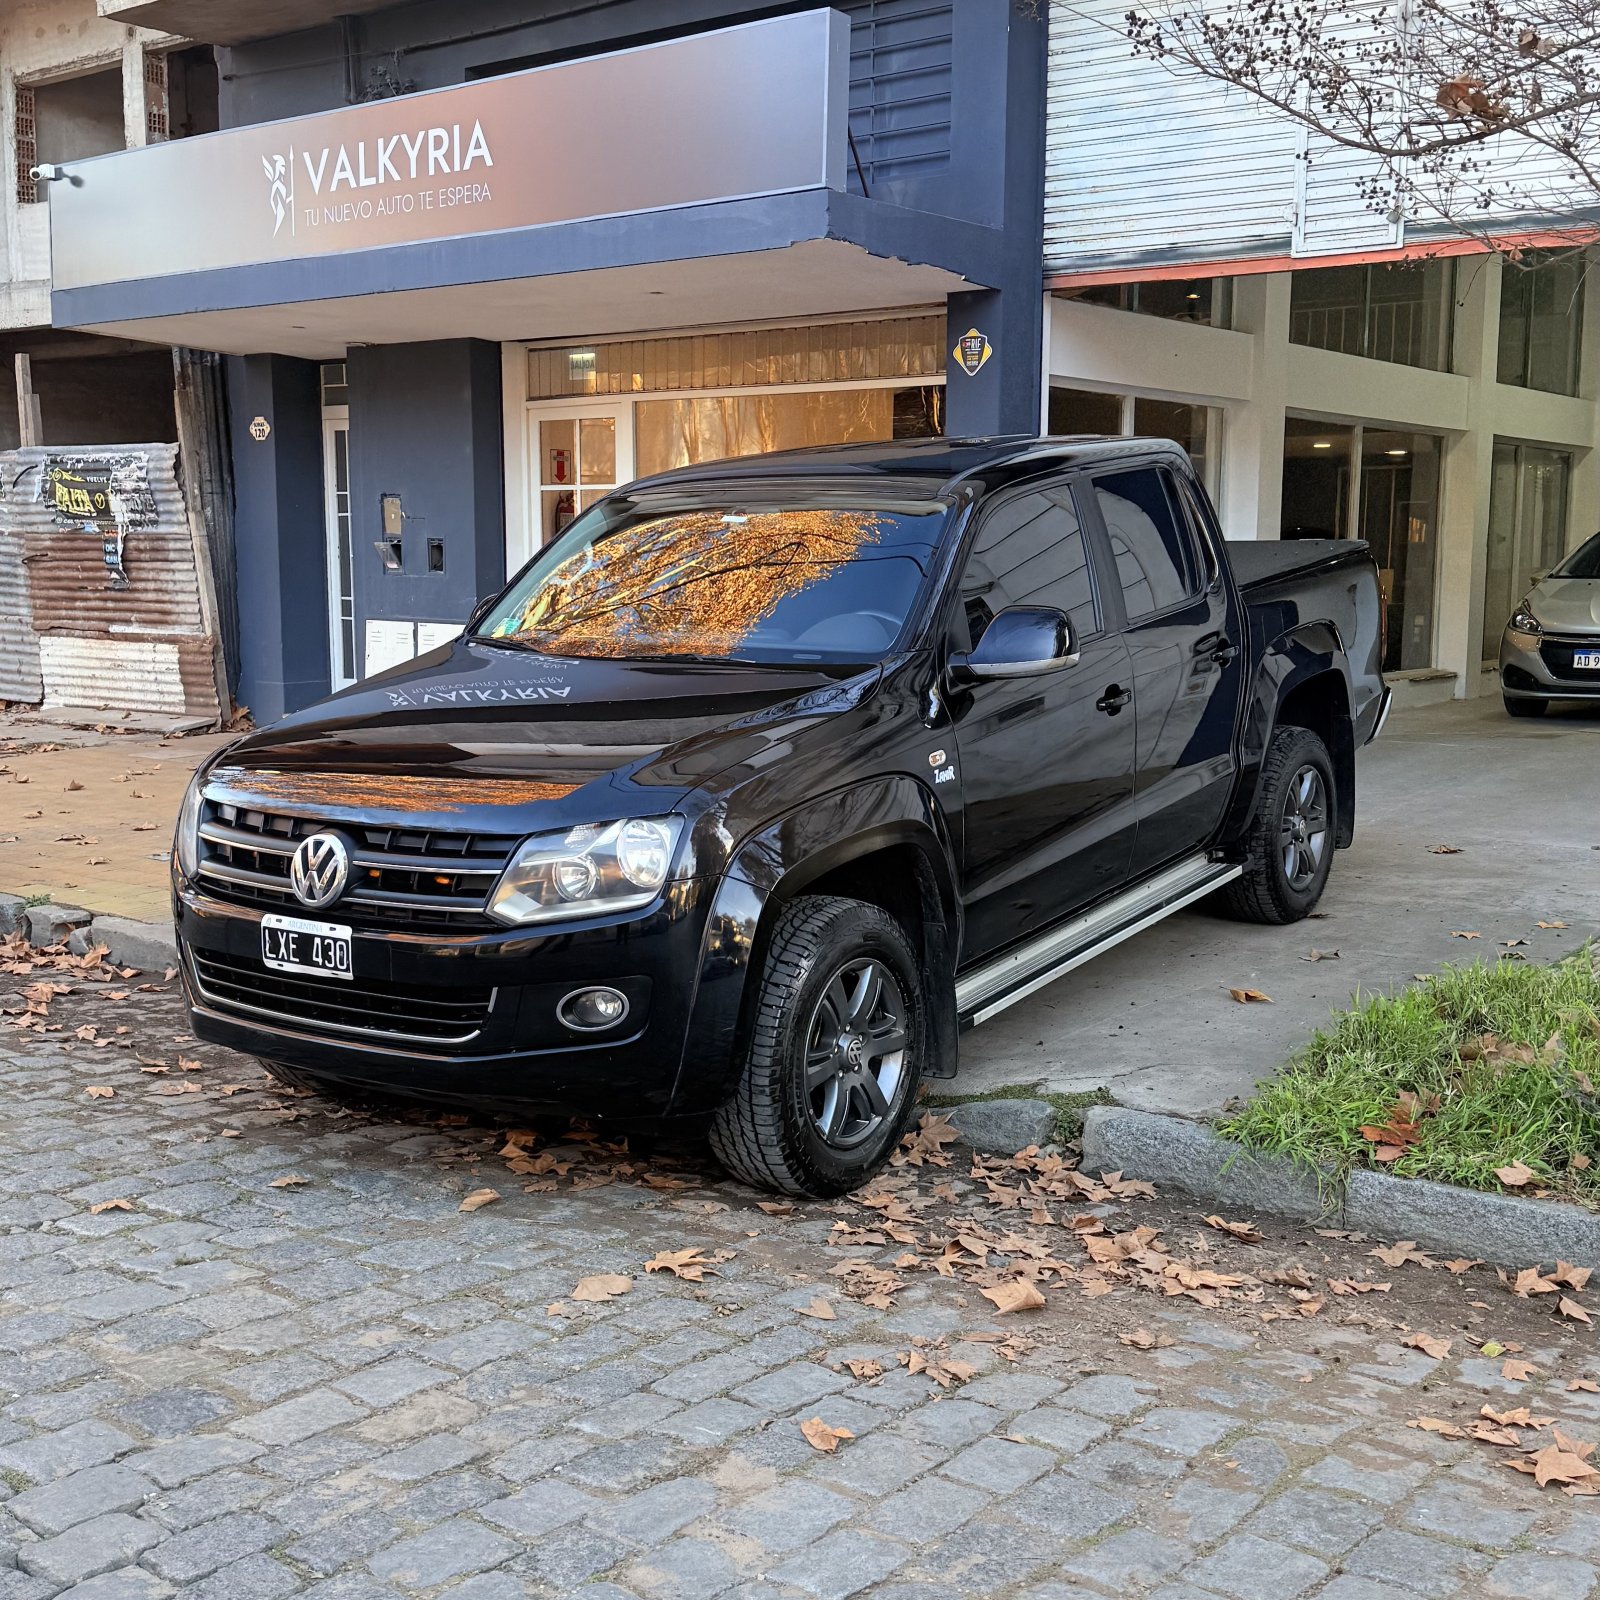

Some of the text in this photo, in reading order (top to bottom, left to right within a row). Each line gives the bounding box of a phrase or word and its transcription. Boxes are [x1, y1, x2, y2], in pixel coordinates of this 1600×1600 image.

[302, 118, 494, 195] VALKYRIA
[304, 182, 492, 227] TU NUEVO AUTO TE ESPERA
[254, 428, 266, 438] 120
[1576, 656, 1590, 666] AD
[288, 920, 324, 934] ARGENTINA
[264, 928, 348, 970] LXE 430
